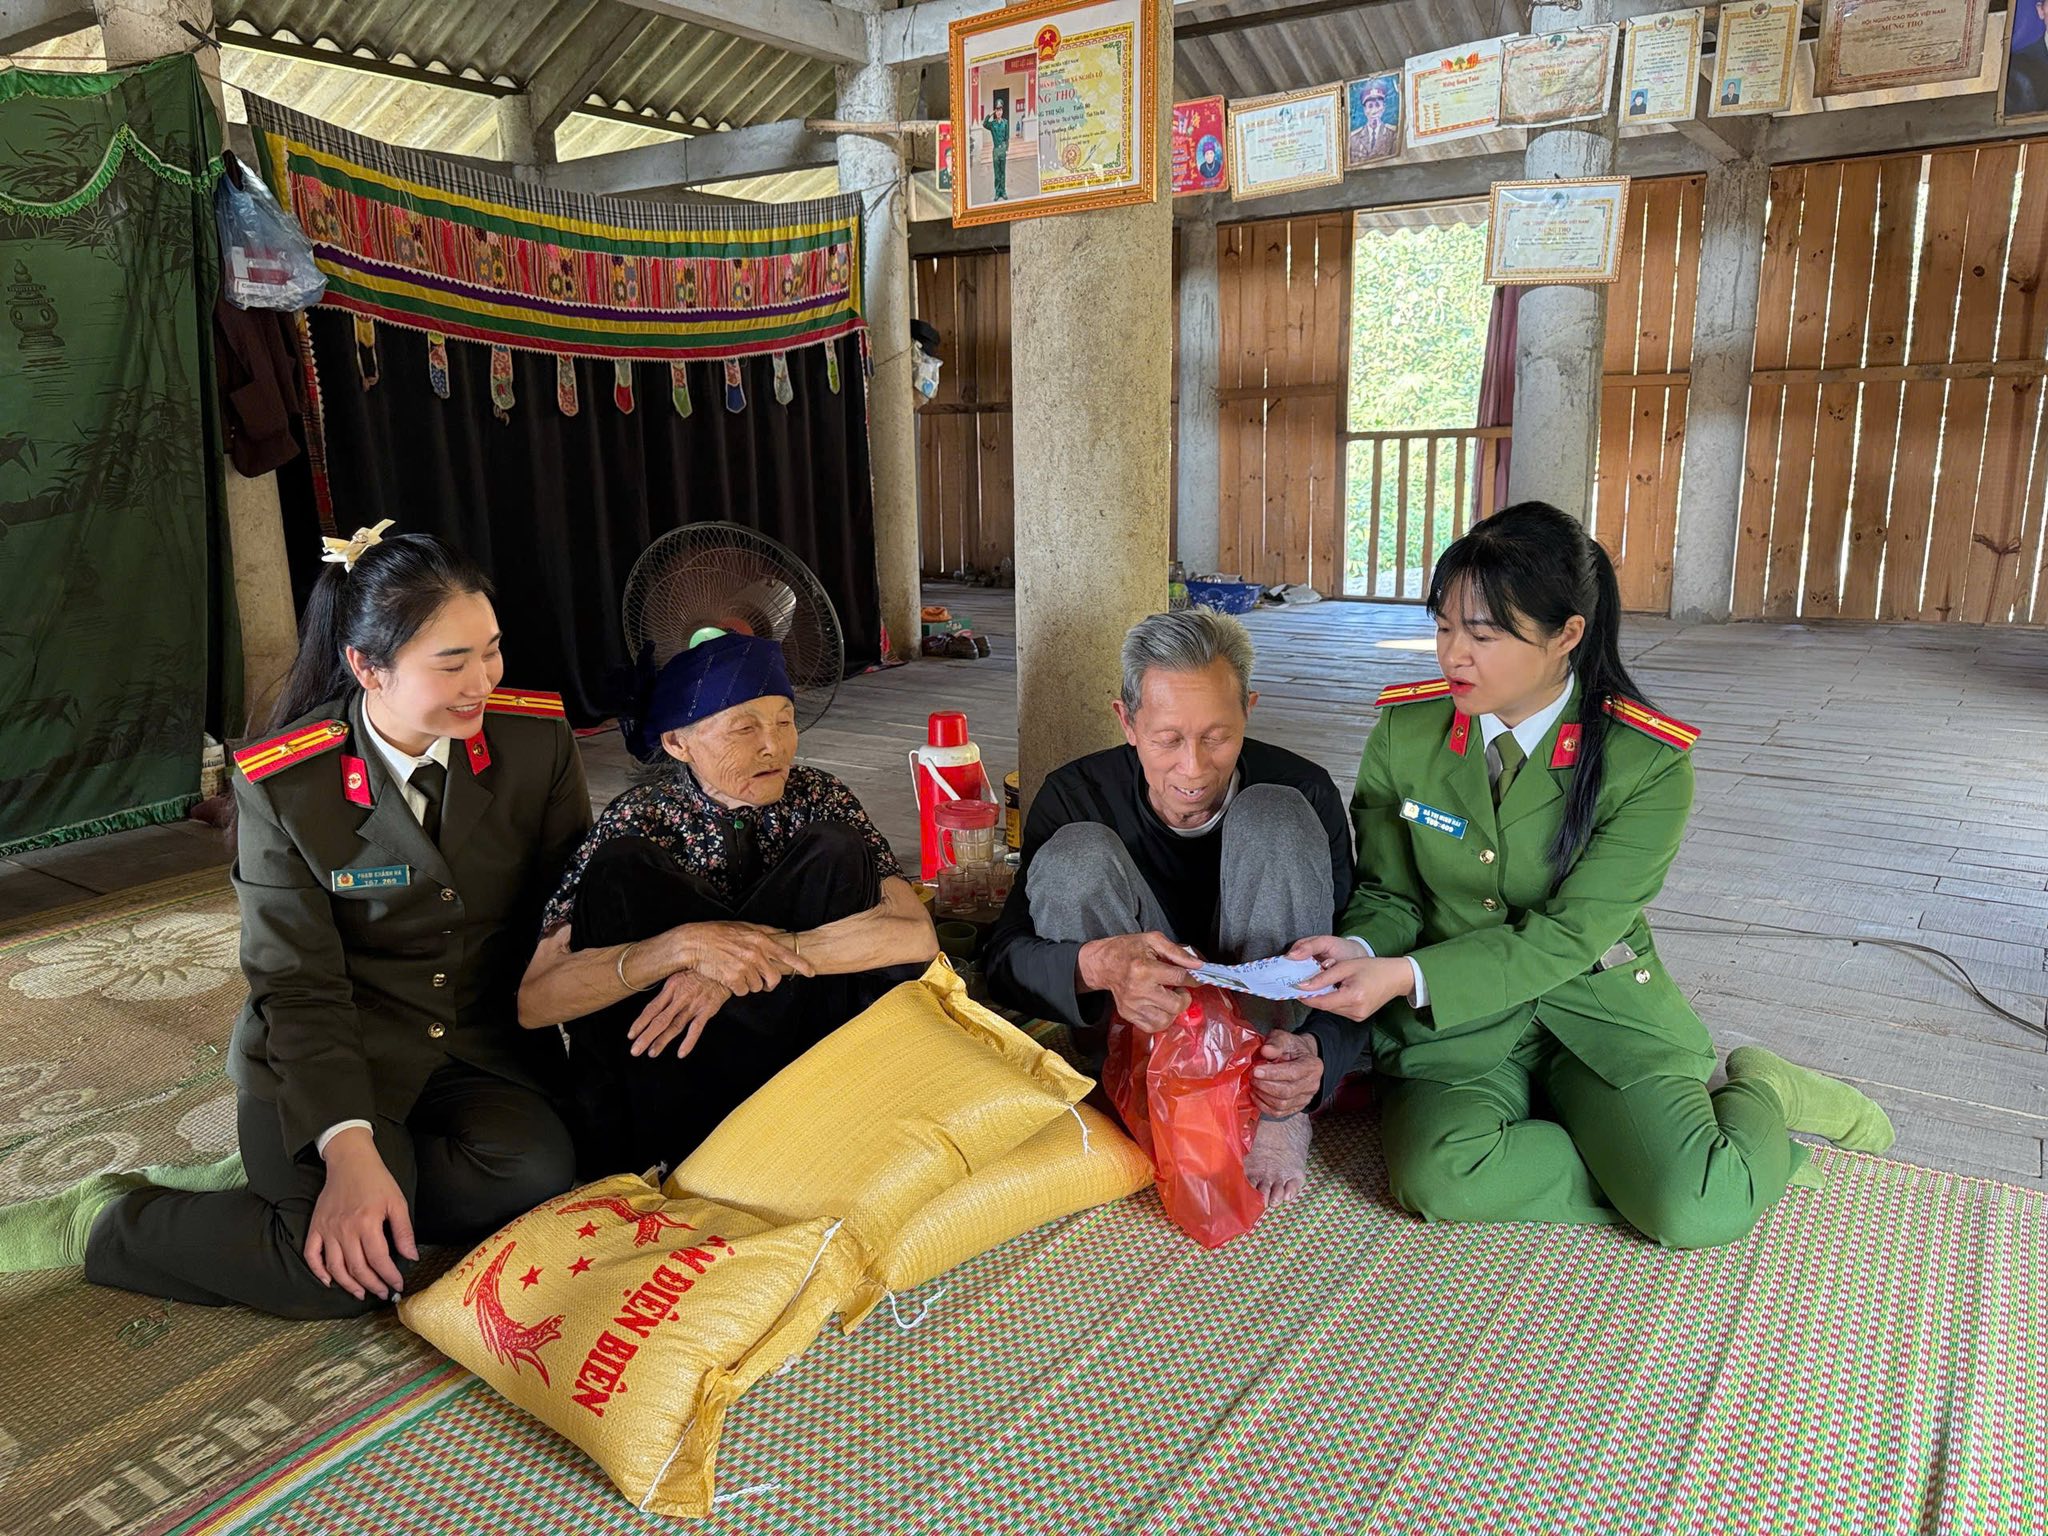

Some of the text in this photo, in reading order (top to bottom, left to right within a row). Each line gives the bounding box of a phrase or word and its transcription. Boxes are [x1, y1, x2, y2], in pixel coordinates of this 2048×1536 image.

[1055, 88, 1075, 101] THỌ
[613, 1263, 696, 1339] ĐIỆN
[571, 1329, 640, 1418] BIÊN
